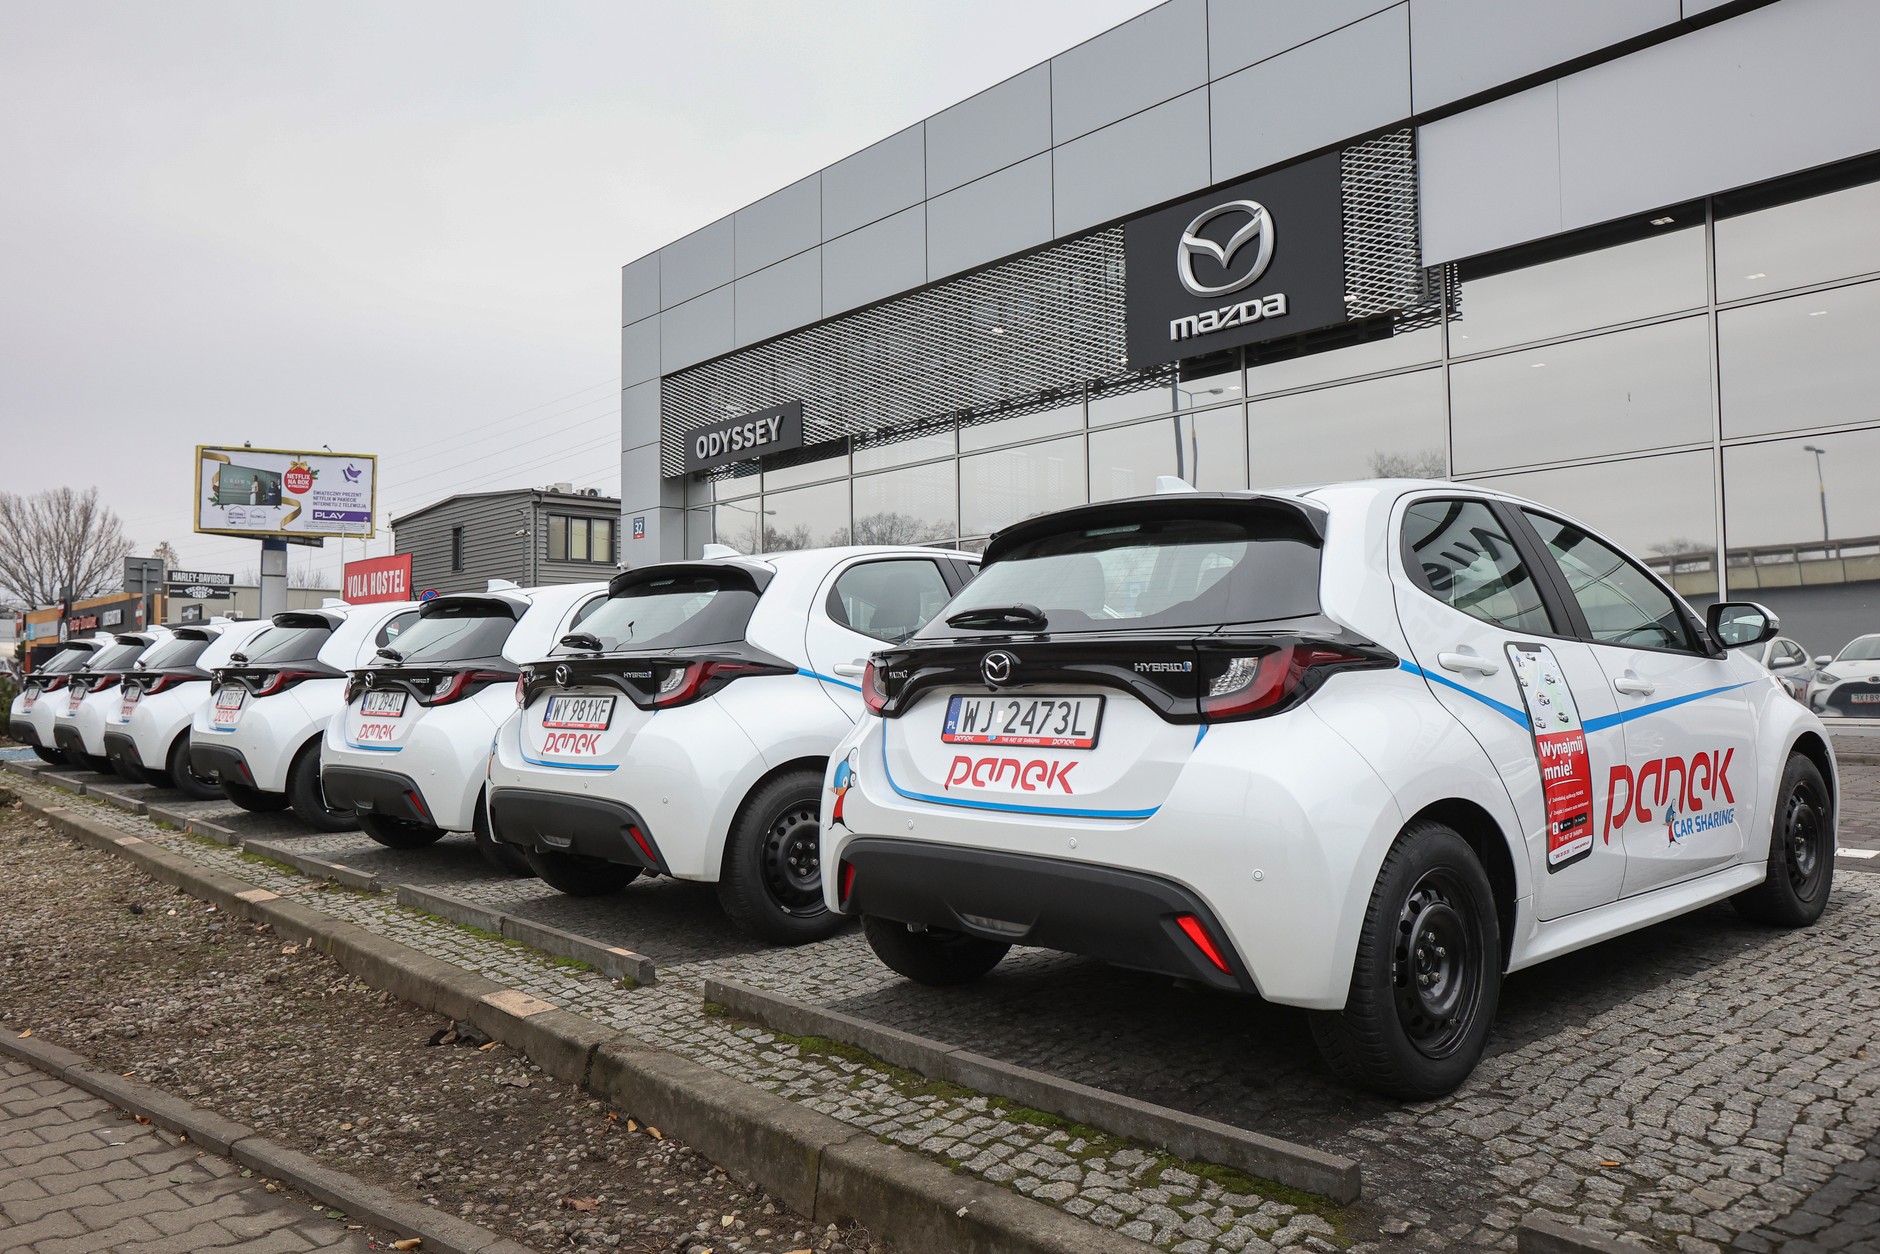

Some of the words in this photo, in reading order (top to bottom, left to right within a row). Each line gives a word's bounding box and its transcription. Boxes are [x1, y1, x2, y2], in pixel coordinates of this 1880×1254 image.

[1170, 292, 1287, 341] mazda
[695, 415, 784, 459] ODYSSEY
[635, 522, 643, 534] 32
[172, 572, 230, 584] HARLEY-DAVIDSON
[347, 574, 368, 598] VOLA
[370, 569, 405, 595] HOSTEL
[1134, 662, 1183, 672] HYBRID
[552, 700, 570, 721] WY
[570, 700, 609, 722] 981XF
[962, 701, 995, 732] WJ
[1003, 701, 1086, 735] 2473L
[947, 720, 956, 730] PL
[1540, 736, 1584, 759] Wynajmij
[1544, 760, 1573, 780] mnie!
[1674, 818, 1694, 838] CAR
[1695, 808, 1734, 832] SHARING
